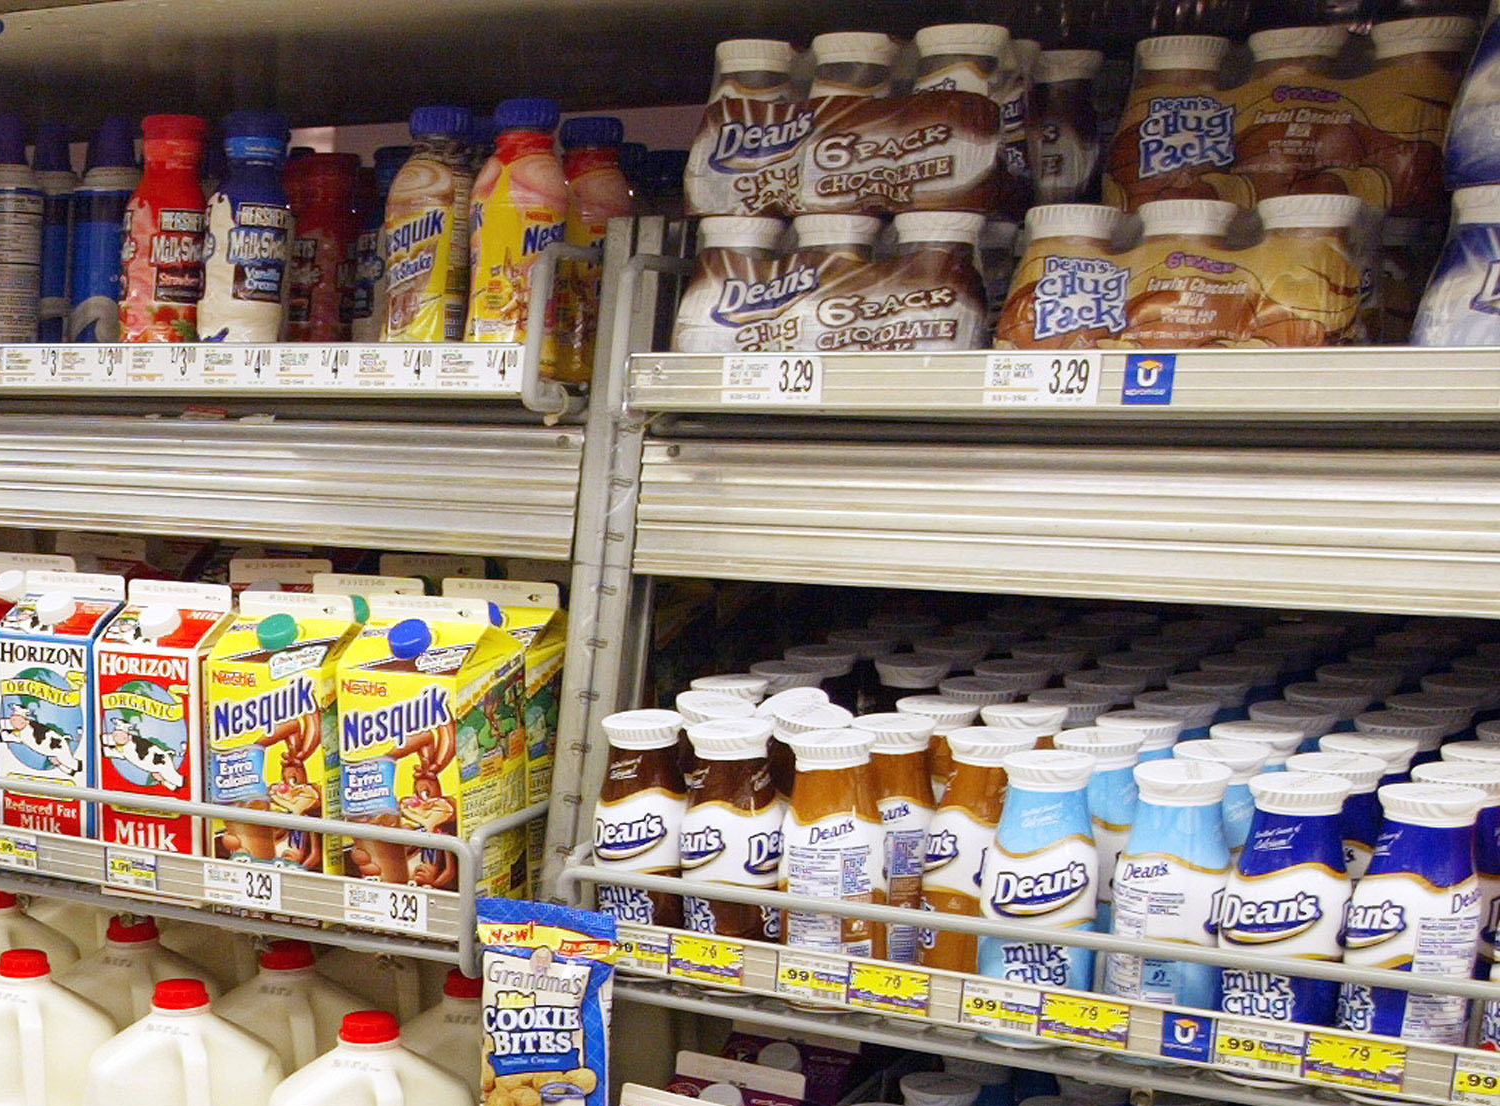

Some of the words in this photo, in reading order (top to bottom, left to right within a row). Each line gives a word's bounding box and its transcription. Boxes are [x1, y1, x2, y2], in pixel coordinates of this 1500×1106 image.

[1149, 97, 1213, 120] Dean's
[718, 108, 814, 161] Dean's
[814, 135, 851, 167] 6
[861, 124, 950, 165] PACK
[1138, 135, 1236, 179] Pack
[816, 155, 953, 198] CHOCOLATE
[857, 180, 912, 202] MILK
[1046, 256, 1110, 276] Dean's
[719, 264, 817, 313] Dean's
[816, 297, 853, 327] 6
[862, 286, 953, 325] PACK
[1035, 294, 1128, 336] Pack
[816, 317, 955, 350] CHOCOLATE
[778, 359, 814, 394] 3.29
[1048, 358, 1090, 396] 3.29
[0, 642, 85, 668] HORIZON
[100, 652, 188, 680] HORIZON
[5, 680, 71, 705] ORGANIC
[107, 693, 175, 717] ORGANIC
[213, 679, 314, 741] Nesquik
[343, 690, 450, 751] Nesquik
[216, 773, 258, 790] Calcium
[220, 763, 253, 777] Extra
[348, 774, 383, 788] Extra
[344, 784, 390, 800] Calcium
[4, 797, 51, 816] Reduced
[56, 804, 78, 819] Fat
[20, 813, 62, 836] Milk
[114, 818, 177, 852] Milk
[595, 814, 666, 846] Dean's
[809, 818, 855, 846] Dean's
[994, 861, 1088, 905] Dean's
[1123, 862, 1170, 882] Dean's
[245, 873, 273, 900] 3.29
[389, 893, 419, 923] 3.29
[1223, 893, 1322, 927] Dean's
[487, 923, 536, 945] New!
[1002, 943, 1067, 966] milk
[487, 961, 587, 1000] Grandma's
[782, 969, 809, 983] .99
[1222, 968, 1289, 994] milk
[483, 1005, 580, 1031] COOKIE
[966, 997, 997, 1013] .99
[493, 1028, 574, 1056] BITES
[1224, 1036, 1256, 1053] .99
[1458, 1072, 1498, 1090] .99
